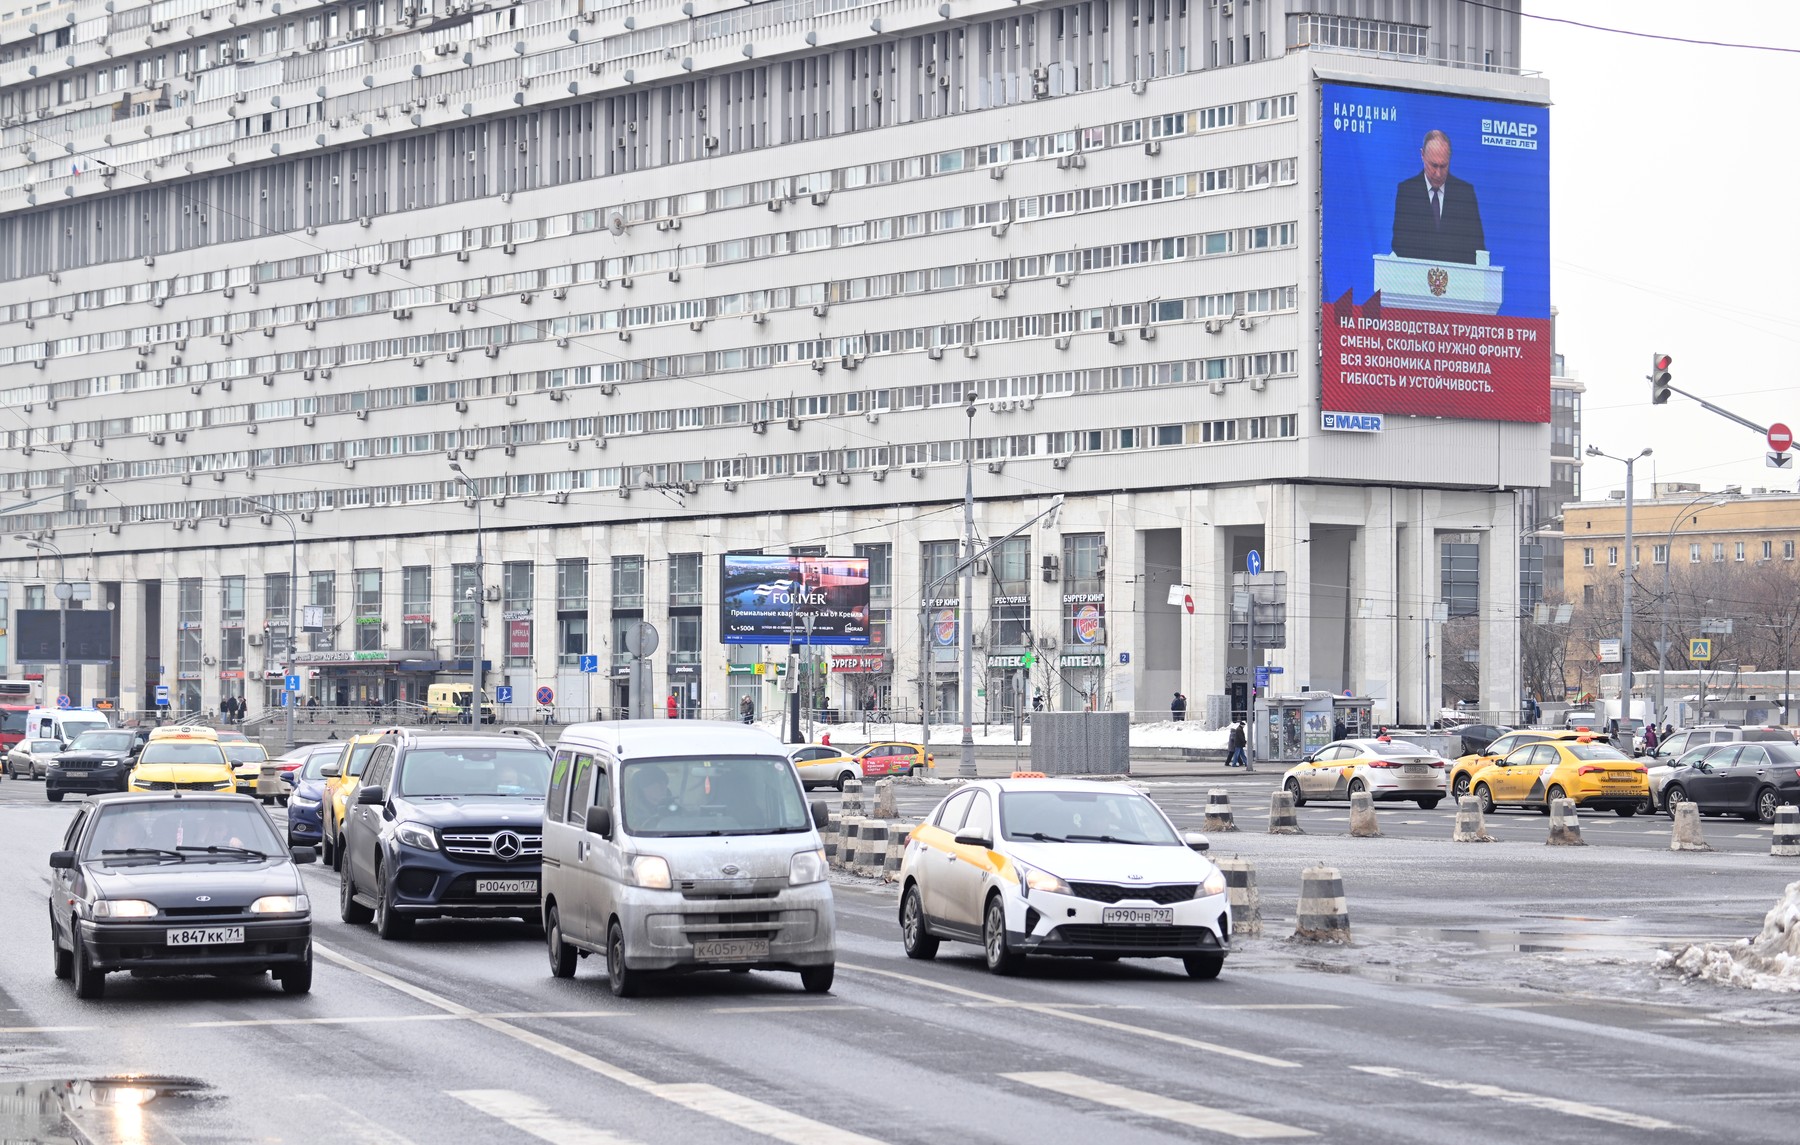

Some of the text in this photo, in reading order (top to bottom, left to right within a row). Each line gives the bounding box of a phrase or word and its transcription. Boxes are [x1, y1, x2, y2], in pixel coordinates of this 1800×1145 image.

[1334, 102, 1397, 122] НАРОДНЫЙ
[1334, 117, 1373, 134] ФРОНТ
[1483, 136, 1536, 149] НАМ 20 ЛЕТ
[1340, 317, 1537, 342] НА ПРОИЗВОДСТВАХ ТРУДЯТСЯ В ТРИ
[1340, 335, 1523, 359] СМЕНЫ, СКОЛЬКО НУЖНО ФРОНТУ.
[1340, 354, 1491, 374] ВСЯ ЭКОНОМИКА ПРОЯВИЛА
[1340, 371, 1494, 393] ГИБКОСТЬ И УСТОЙЧИВОСТЬ.
[1336, 415, 1381, 431] MAER
[995, 596, 1027, 604] РЕСТОРАН
[1063, 593, 1104, 602] БУРГЕР КИНГ
[731, 609, 776, 617] Премиальные
[1080, 619, 1097, 634] KING
[831, 658, 858, 668] БУРГЕР
[988, 656, 1025, 667] АПТЕК
[1061, 656, 1102, 667] АПТЕКА
[1121, 654, 1127, 662] 2
[480, 880, 535, 892] Р004УО 177
[1107, 909, 1170, 922] Н990НВ 797
[172, 928, 240, 944] К847КК 71
[698, 941, 766, 956] К405РУ 799
